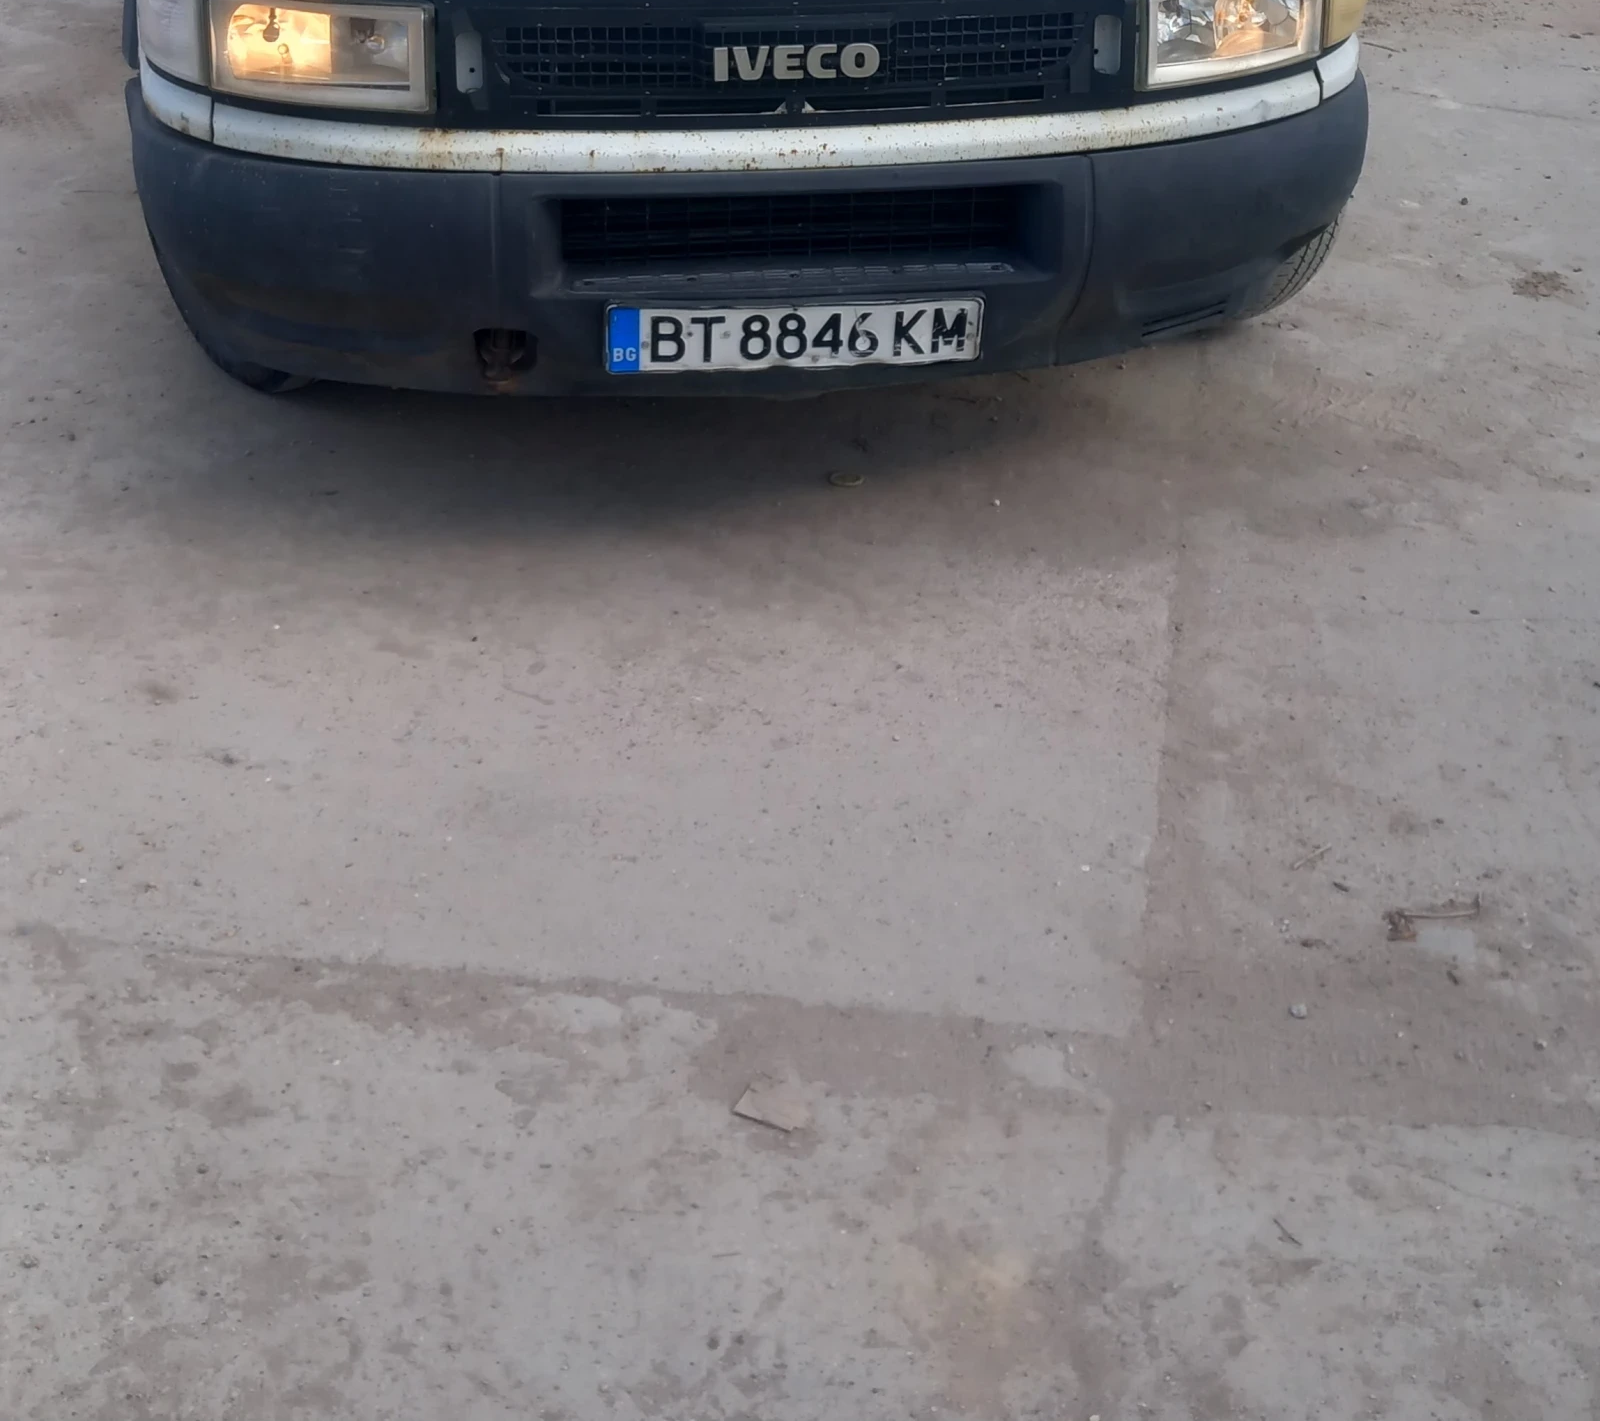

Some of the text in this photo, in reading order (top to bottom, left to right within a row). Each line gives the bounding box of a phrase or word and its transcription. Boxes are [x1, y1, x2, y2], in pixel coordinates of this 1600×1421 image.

[713, 42, 880, 82] IVECO
[611, 347, 637, 363] BG
[649, 307, 968, 364] BT 8846 KM
